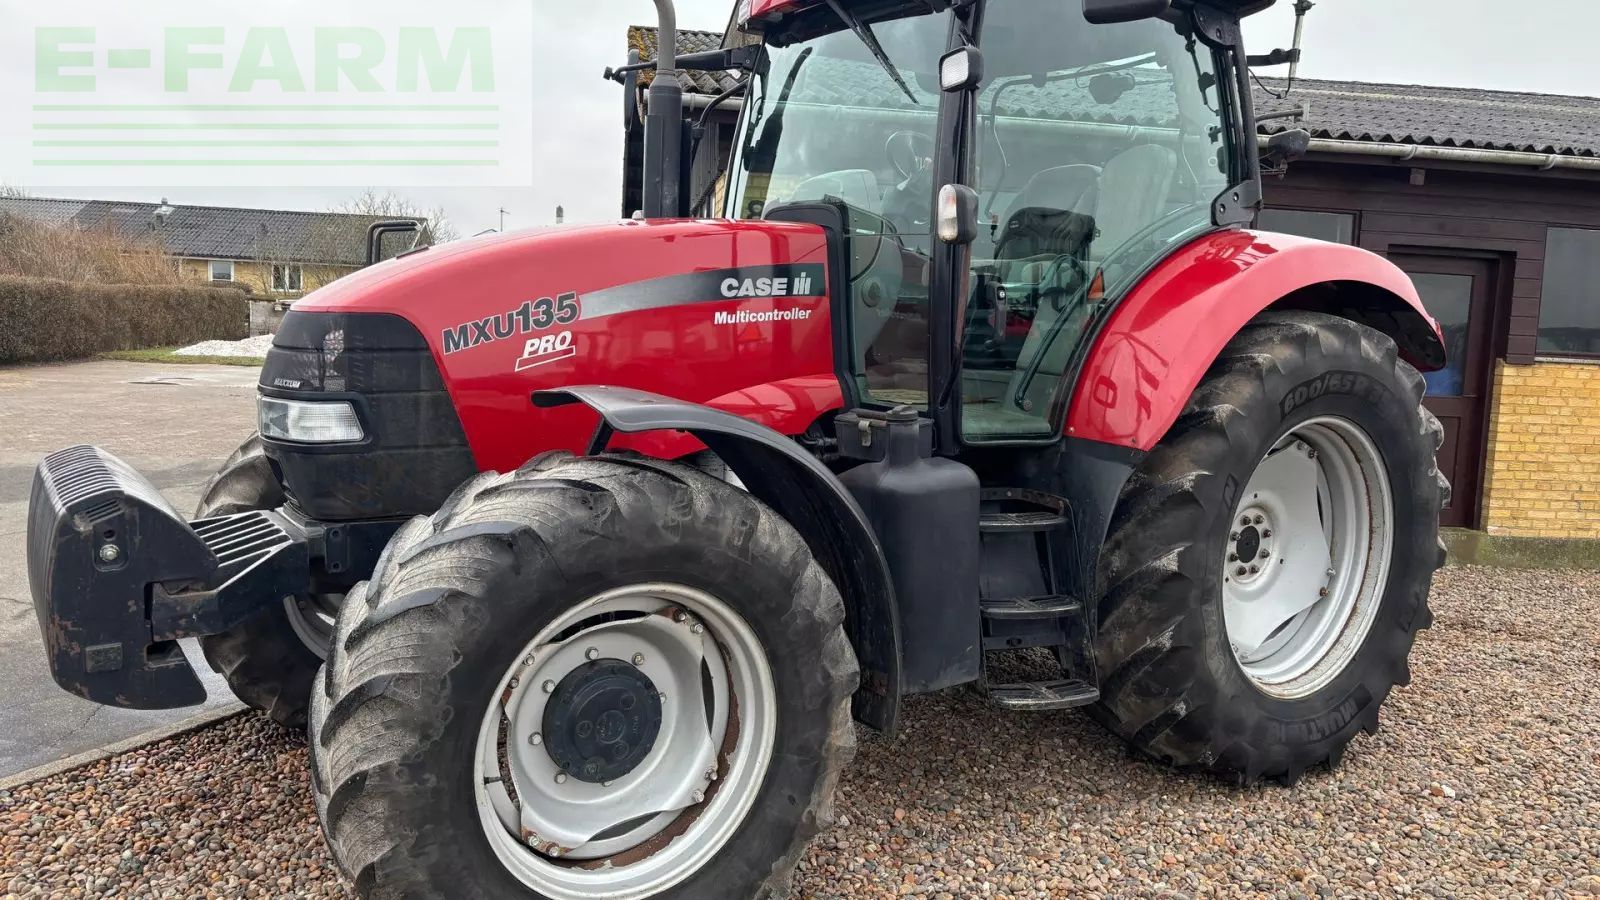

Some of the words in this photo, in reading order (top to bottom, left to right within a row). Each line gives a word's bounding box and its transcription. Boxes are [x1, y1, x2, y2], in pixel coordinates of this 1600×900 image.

[720, 277, 788, 298] CASE
[442, 292, 579, 355] MXU135
[713, 307, 812, 326] Multicontroller
[522, 331, 574, 359] PRO
